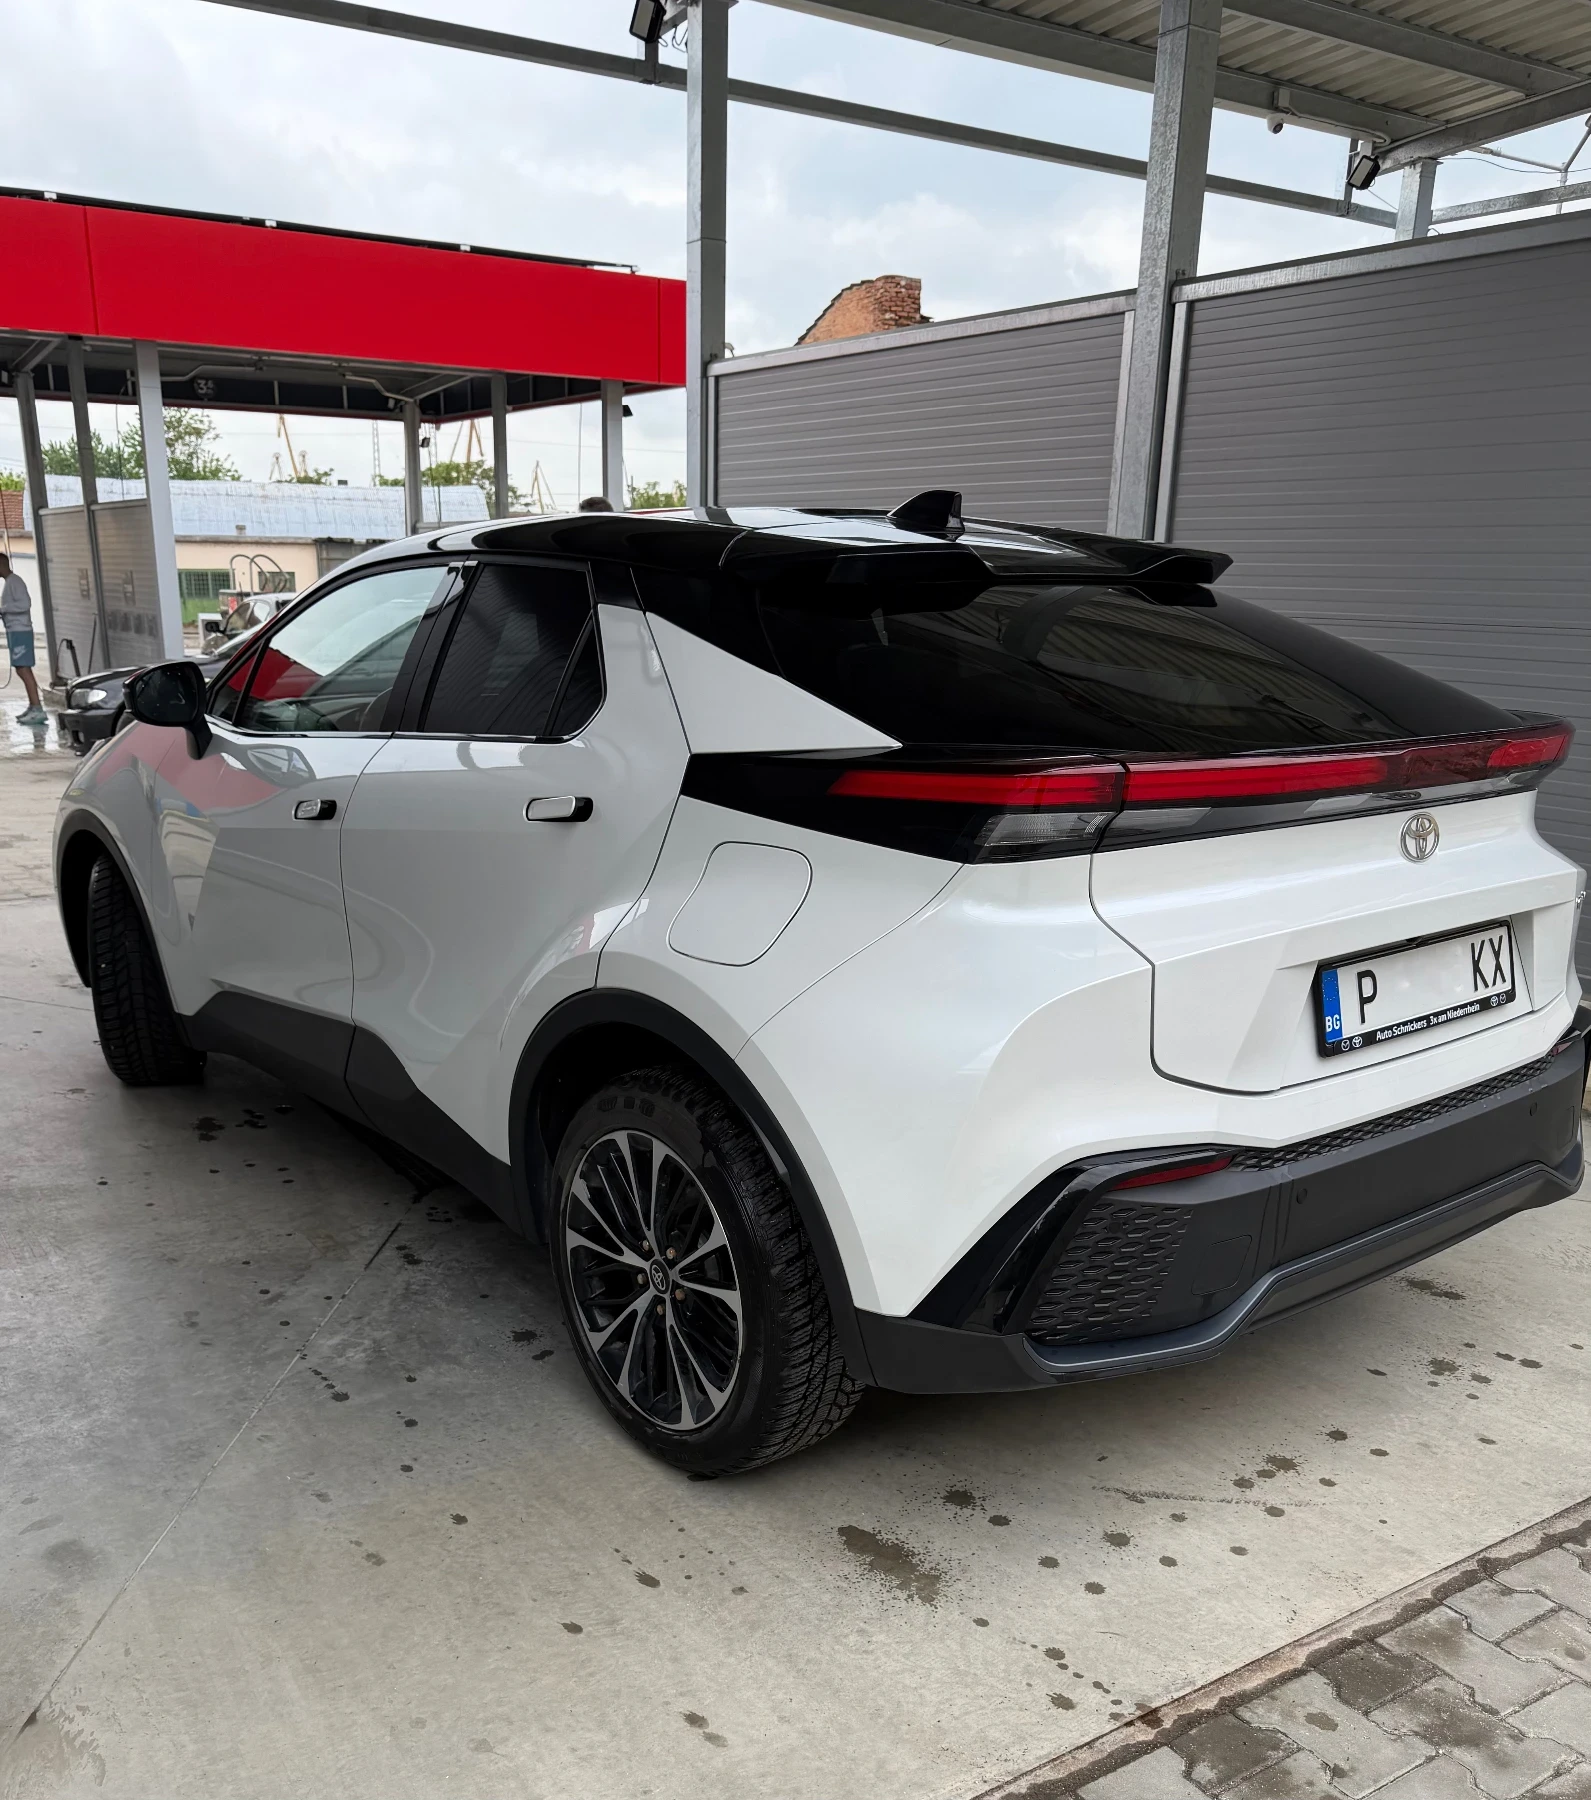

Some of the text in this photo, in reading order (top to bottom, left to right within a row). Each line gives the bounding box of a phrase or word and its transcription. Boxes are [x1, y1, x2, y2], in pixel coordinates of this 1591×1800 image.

[1356, 934, 1507, 1024] P KX
[1325, 1014, 1341, 1033] BG
[1376, 1002, 1480, 1041] Auto Schnickers 3x am Niederrhein
